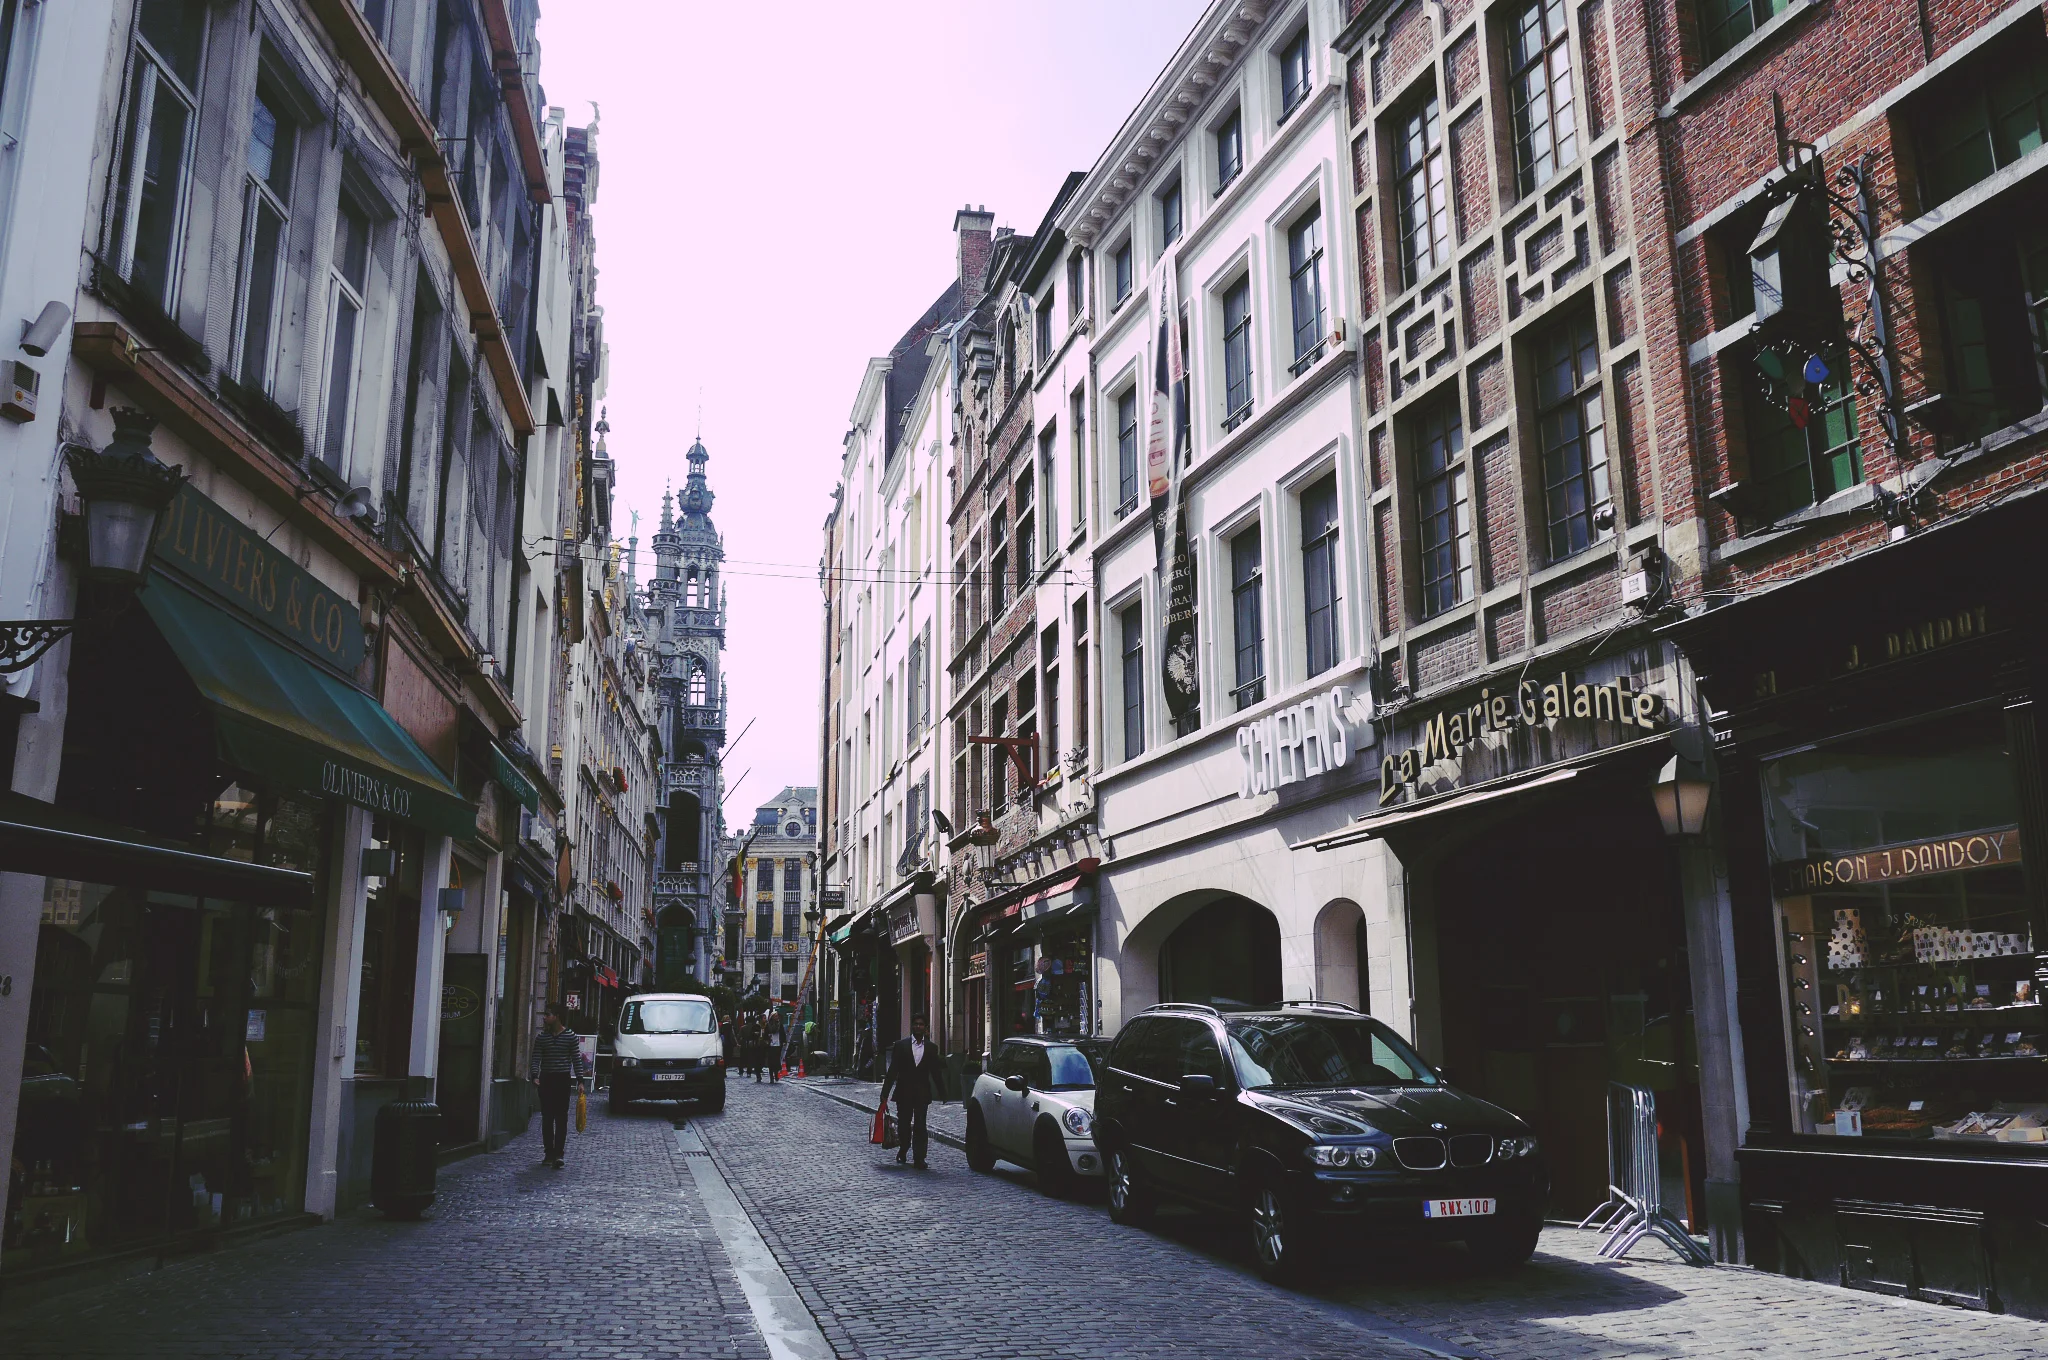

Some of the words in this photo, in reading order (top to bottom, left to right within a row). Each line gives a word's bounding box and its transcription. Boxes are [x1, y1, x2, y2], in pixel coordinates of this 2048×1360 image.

[285, 576, 302, 631] &
[310, 592, 346, 658] CO.
[1885, 603, 1986, 660] DANDOY
[1236, 686, 1351, 799] SCHEPENS
[1379, 749, 1419, 807] La
[1424, 688, 1510, 766] Marie
[1519, 672, 1658, 729] Galante
[322, 761, 379, 807] OLIVIERS
[381, 783, 391, 811] &
[1788, 856, 1869, 891] MAISON
